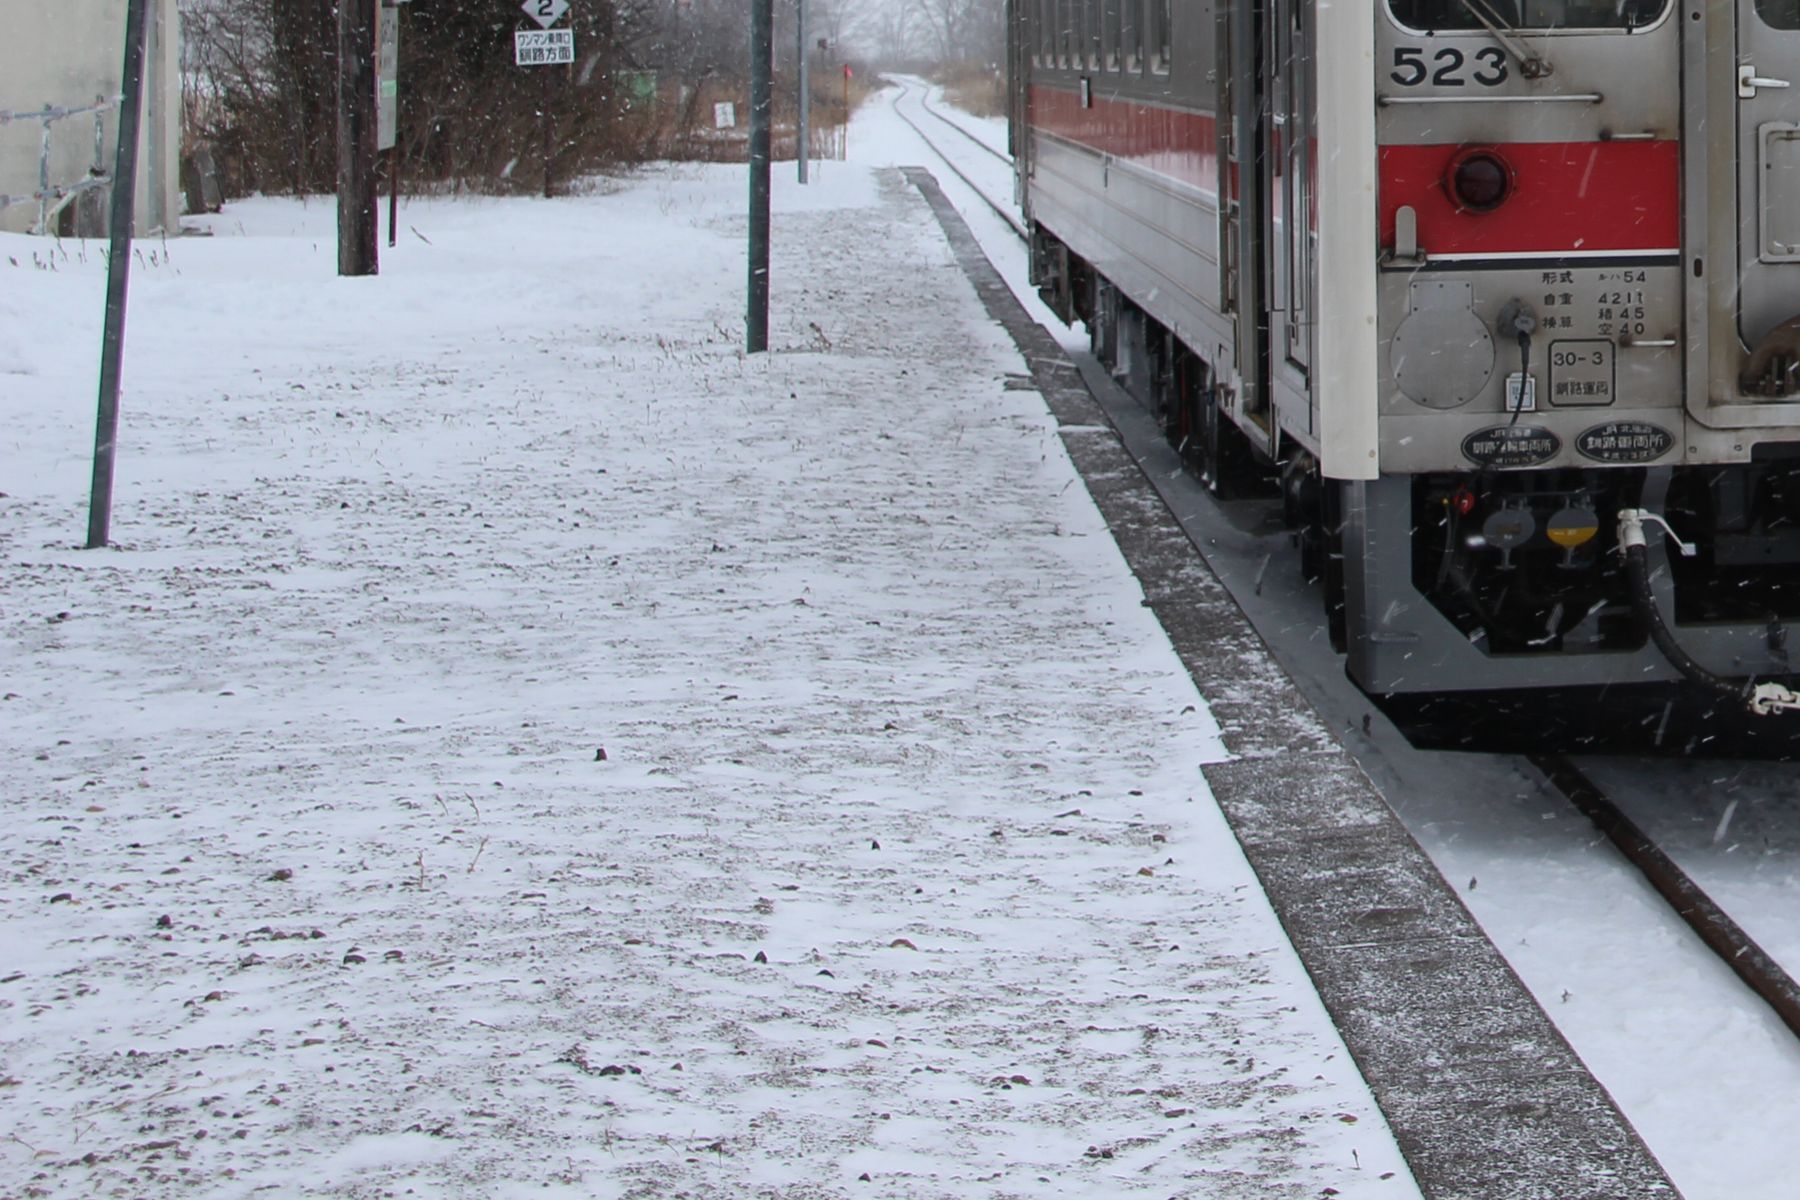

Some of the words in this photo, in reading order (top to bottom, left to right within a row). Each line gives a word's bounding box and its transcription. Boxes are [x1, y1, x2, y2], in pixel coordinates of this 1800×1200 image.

[517, 33, 570, 46] ワンマン乗降口
[519, 46, 571, 62] 釧路方面
[1389, 46, 1510, 87] 523
[1542, 270, 1574, 284] 形式
